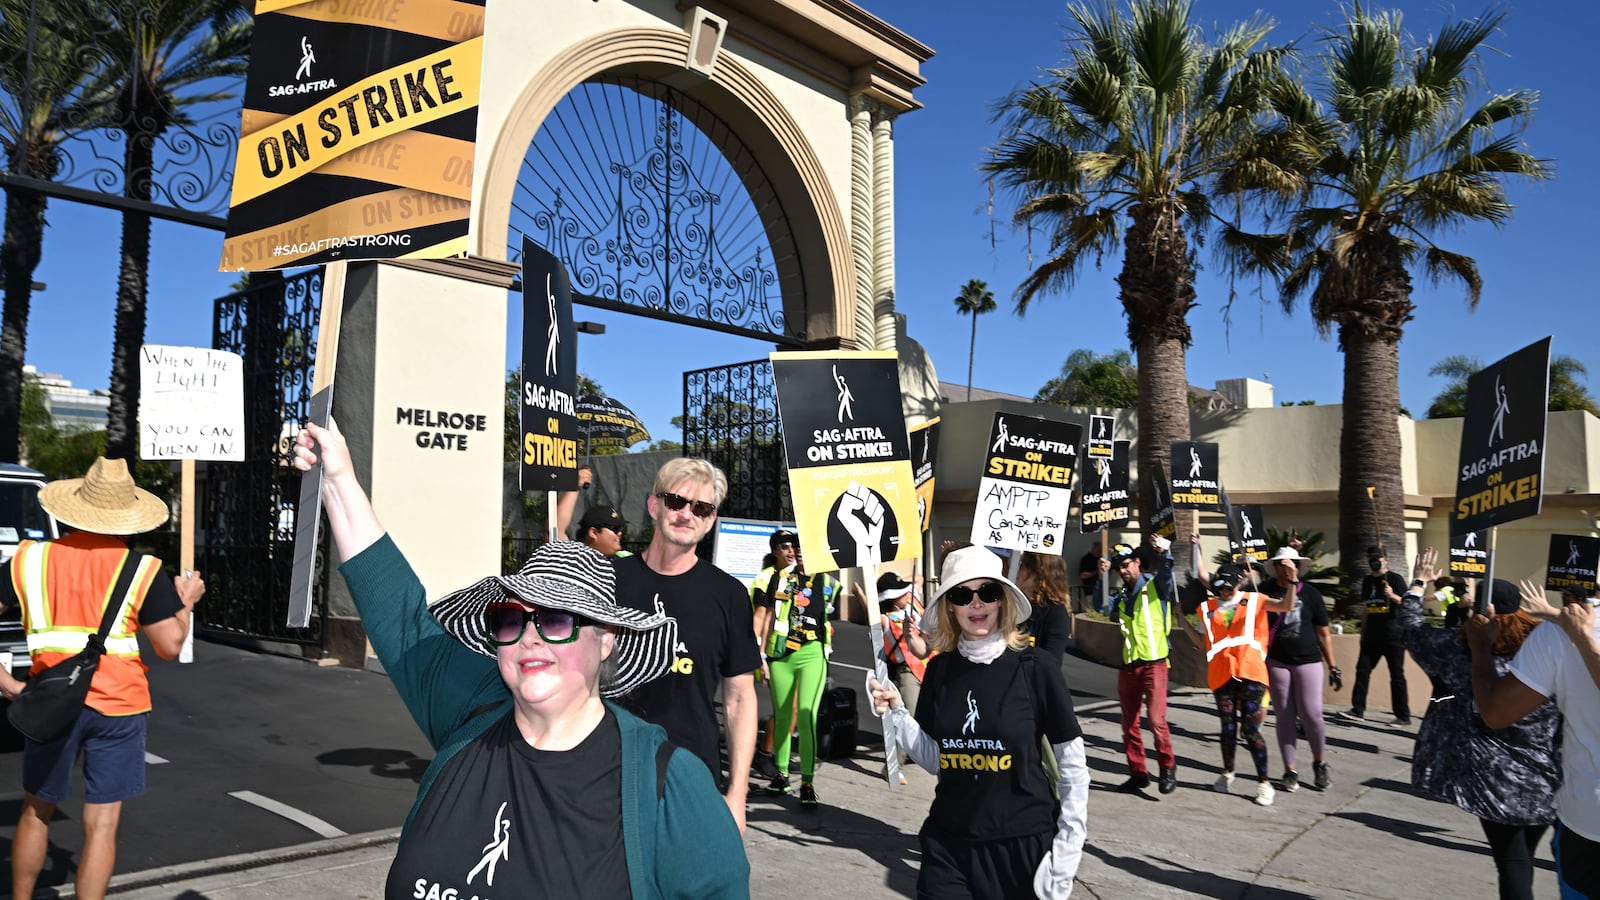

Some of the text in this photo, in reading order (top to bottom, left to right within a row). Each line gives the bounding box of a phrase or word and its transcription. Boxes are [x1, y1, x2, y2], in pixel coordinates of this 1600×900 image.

[257, 59, 462, 179] ON STRIKE
[362, 199, 392, 227] ON
[273, 234, 411, 257] #SAGAFTRASTRONG
[143, 347, 232, 371] WHEN THE
[157, 371, 218, 391] LIGHT
[396, 407, 487, 431] MELROSE
[547, 417, 559, 434] ON
[148, 424, 234, 442] YOU CAN
[416, 431, 468, 451] GATE
[144, 442, 198, 456] TURN
[525, 432, 577, 470] STRIKE!
[807, 442, 894, 461] ON STRIKE!
[1025, 452, 1042, 462] ON
[988, 457, 1072, 484] STRIKE!
[1487, 471, 1502, 486] ON
[984, 483, 1050, 510] AMPTP
[1172, 493, 1219, 504] STRIKE!
[1457, 474, 1538, 519] STRIKE!
[988, 508, 1013, 531] Can
[1014, 514, 1029, 528] Be
[1044, 516, 1062, 529] Poor
[1083, 507, 1129, 525] STRIKE!
[939, 753, 1012, 772] STRONG
